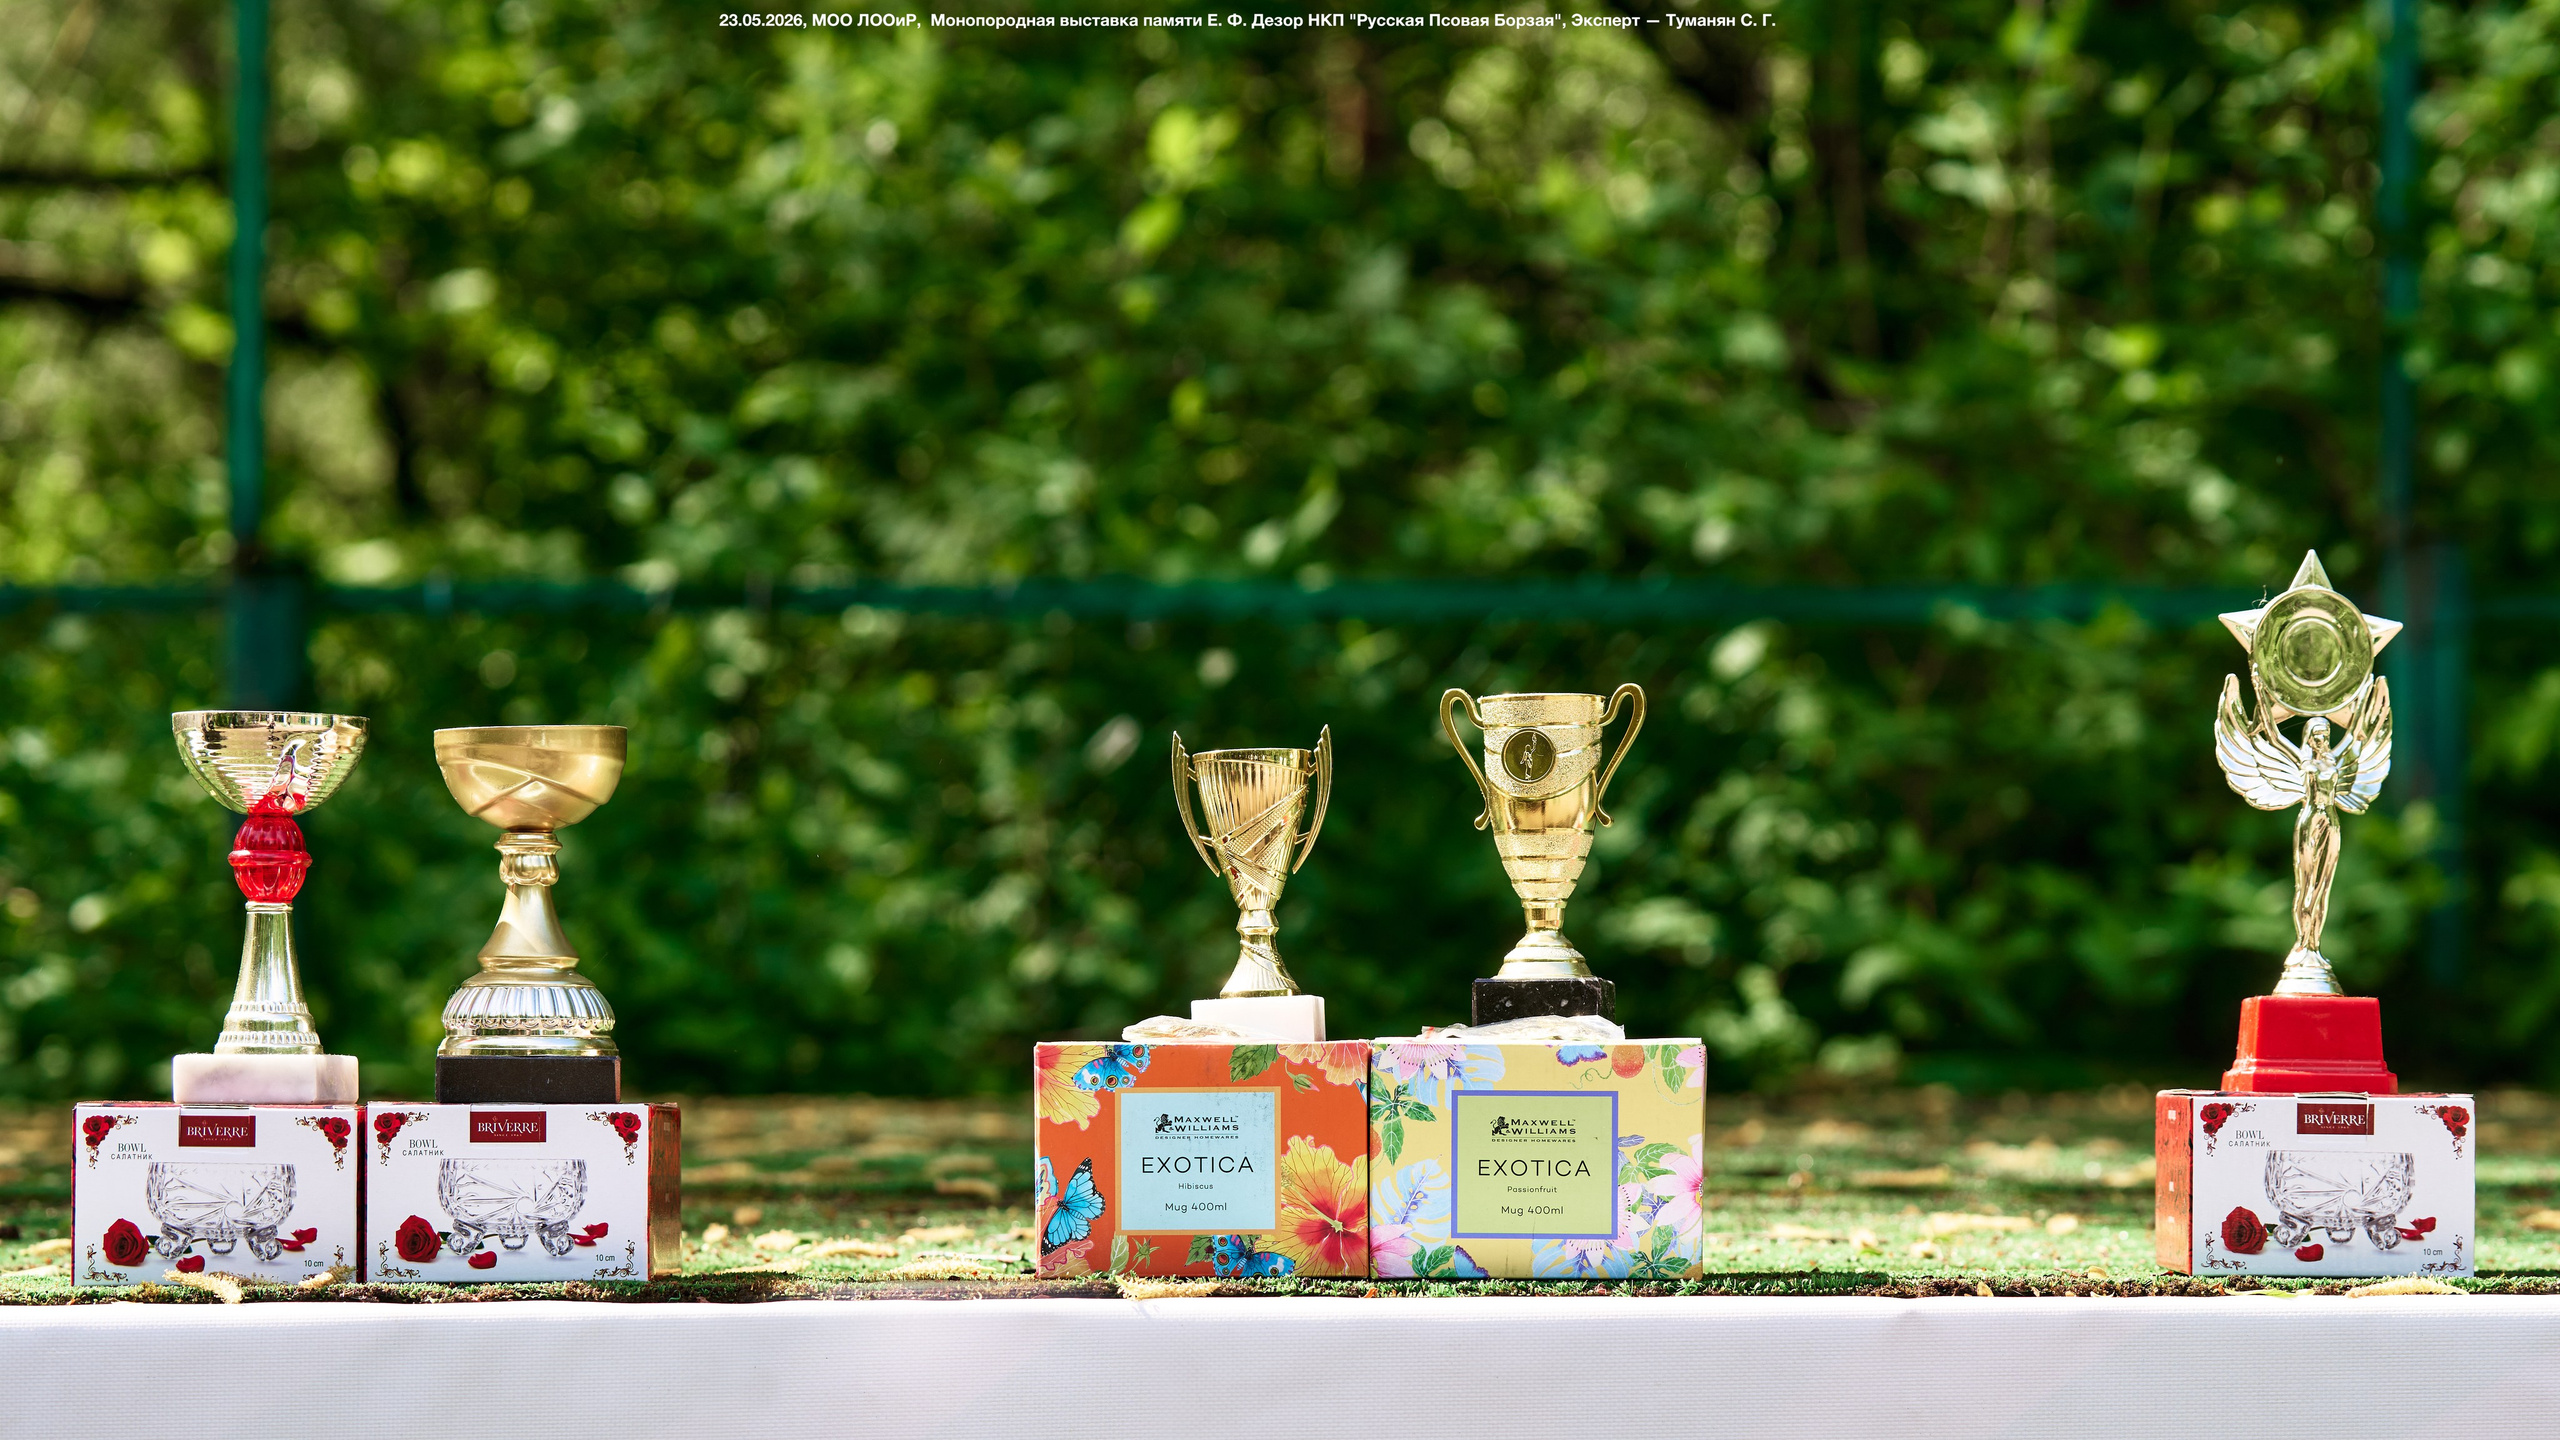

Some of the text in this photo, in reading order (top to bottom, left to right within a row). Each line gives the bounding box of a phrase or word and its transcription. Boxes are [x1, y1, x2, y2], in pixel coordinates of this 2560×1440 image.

[2304, 1111, 2366, 1127] BRIVERRE
[187, 1123, 248, 1138] BRIVERRE
[478, 1119, 538, 1134] BRIVERRE
[1174, 1124, 1239, 1132] WILLIAMS
[2235, 1130, 2265, 1140] BOWL
[118, 1143, 147, 1153] BOWL
[409, 1139, 438, 1149] BOWL
[402, 1149, 444, 1157] САЛАТНИК
[1142, 1156, 1254, 1174] EXOTICA
[1478, 1159, 1591, 1177] EXOTICA
[1507, 1185, 1558, 1194] Passionfruit
[1165, 1202, 1227, 1213] Mug 400ml
[1501, 1206, 1564, 1217] Mug 400ml
[2423, 1248, 2431, 1256] 10
[595, 1254, 603, 1262] 10
[304, 1260, 311, 1268] 10
